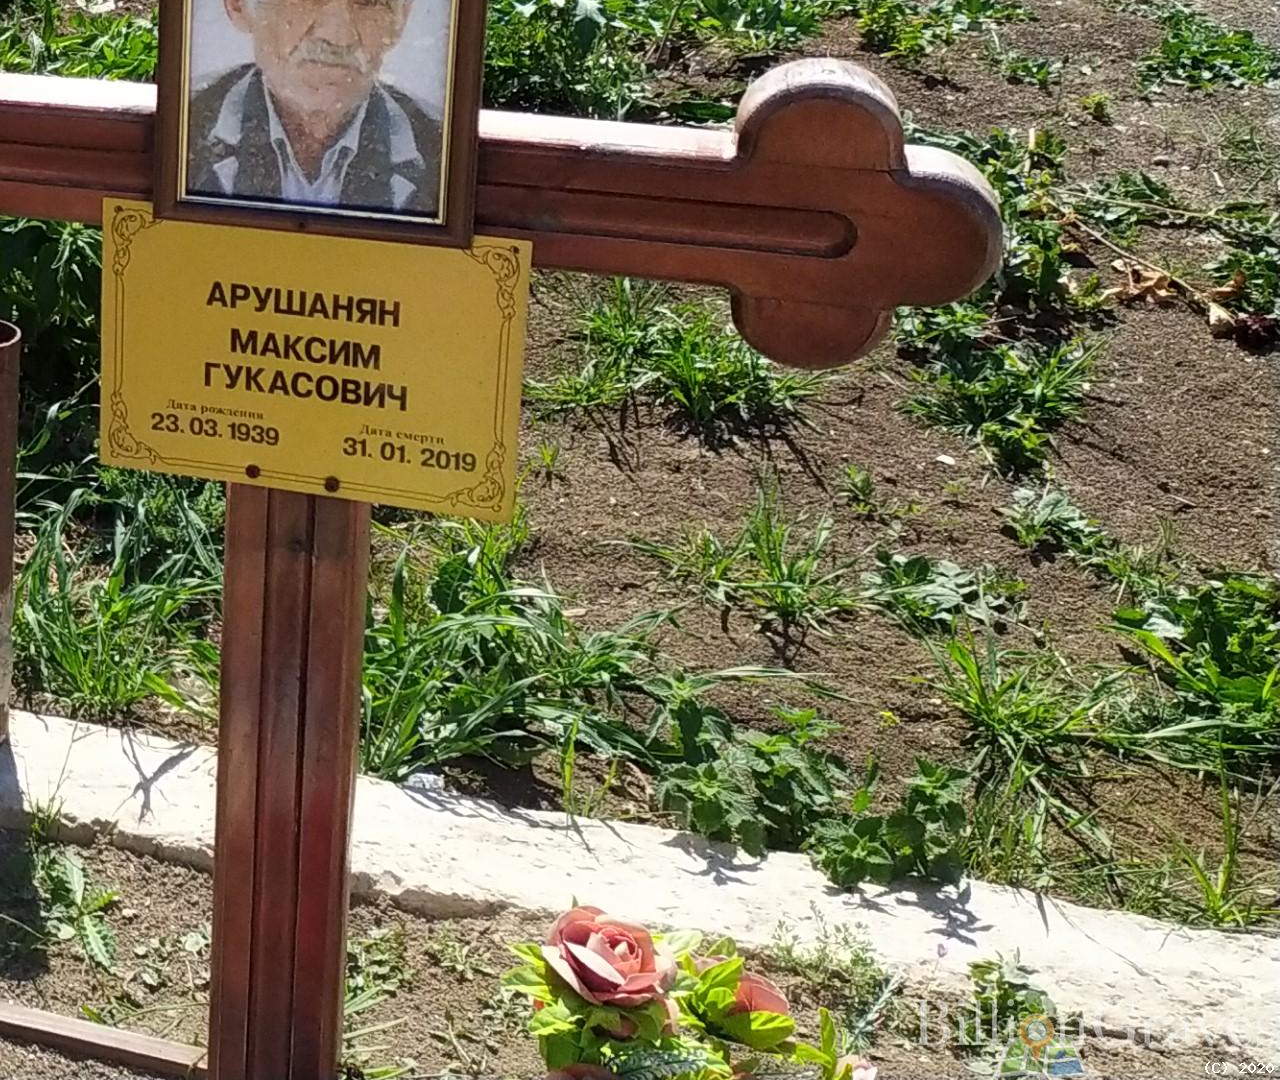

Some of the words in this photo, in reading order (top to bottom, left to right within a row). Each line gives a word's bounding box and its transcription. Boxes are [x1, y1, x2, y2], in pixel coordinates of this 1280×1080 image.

[205, 280, 401, 328] АРУШАНЯН
[230, 327, 382, 371] МАКСИМ
[203, 361, 408, 412] ГУКАСОВИЧ
[166, 399, 197, 412] Дата
[227, 421, 281, 447] 1939
[359, 423, 393, 438] Дата
[395, 430, 445, 446] смерти
[419, 447, 478, 473] 2019
